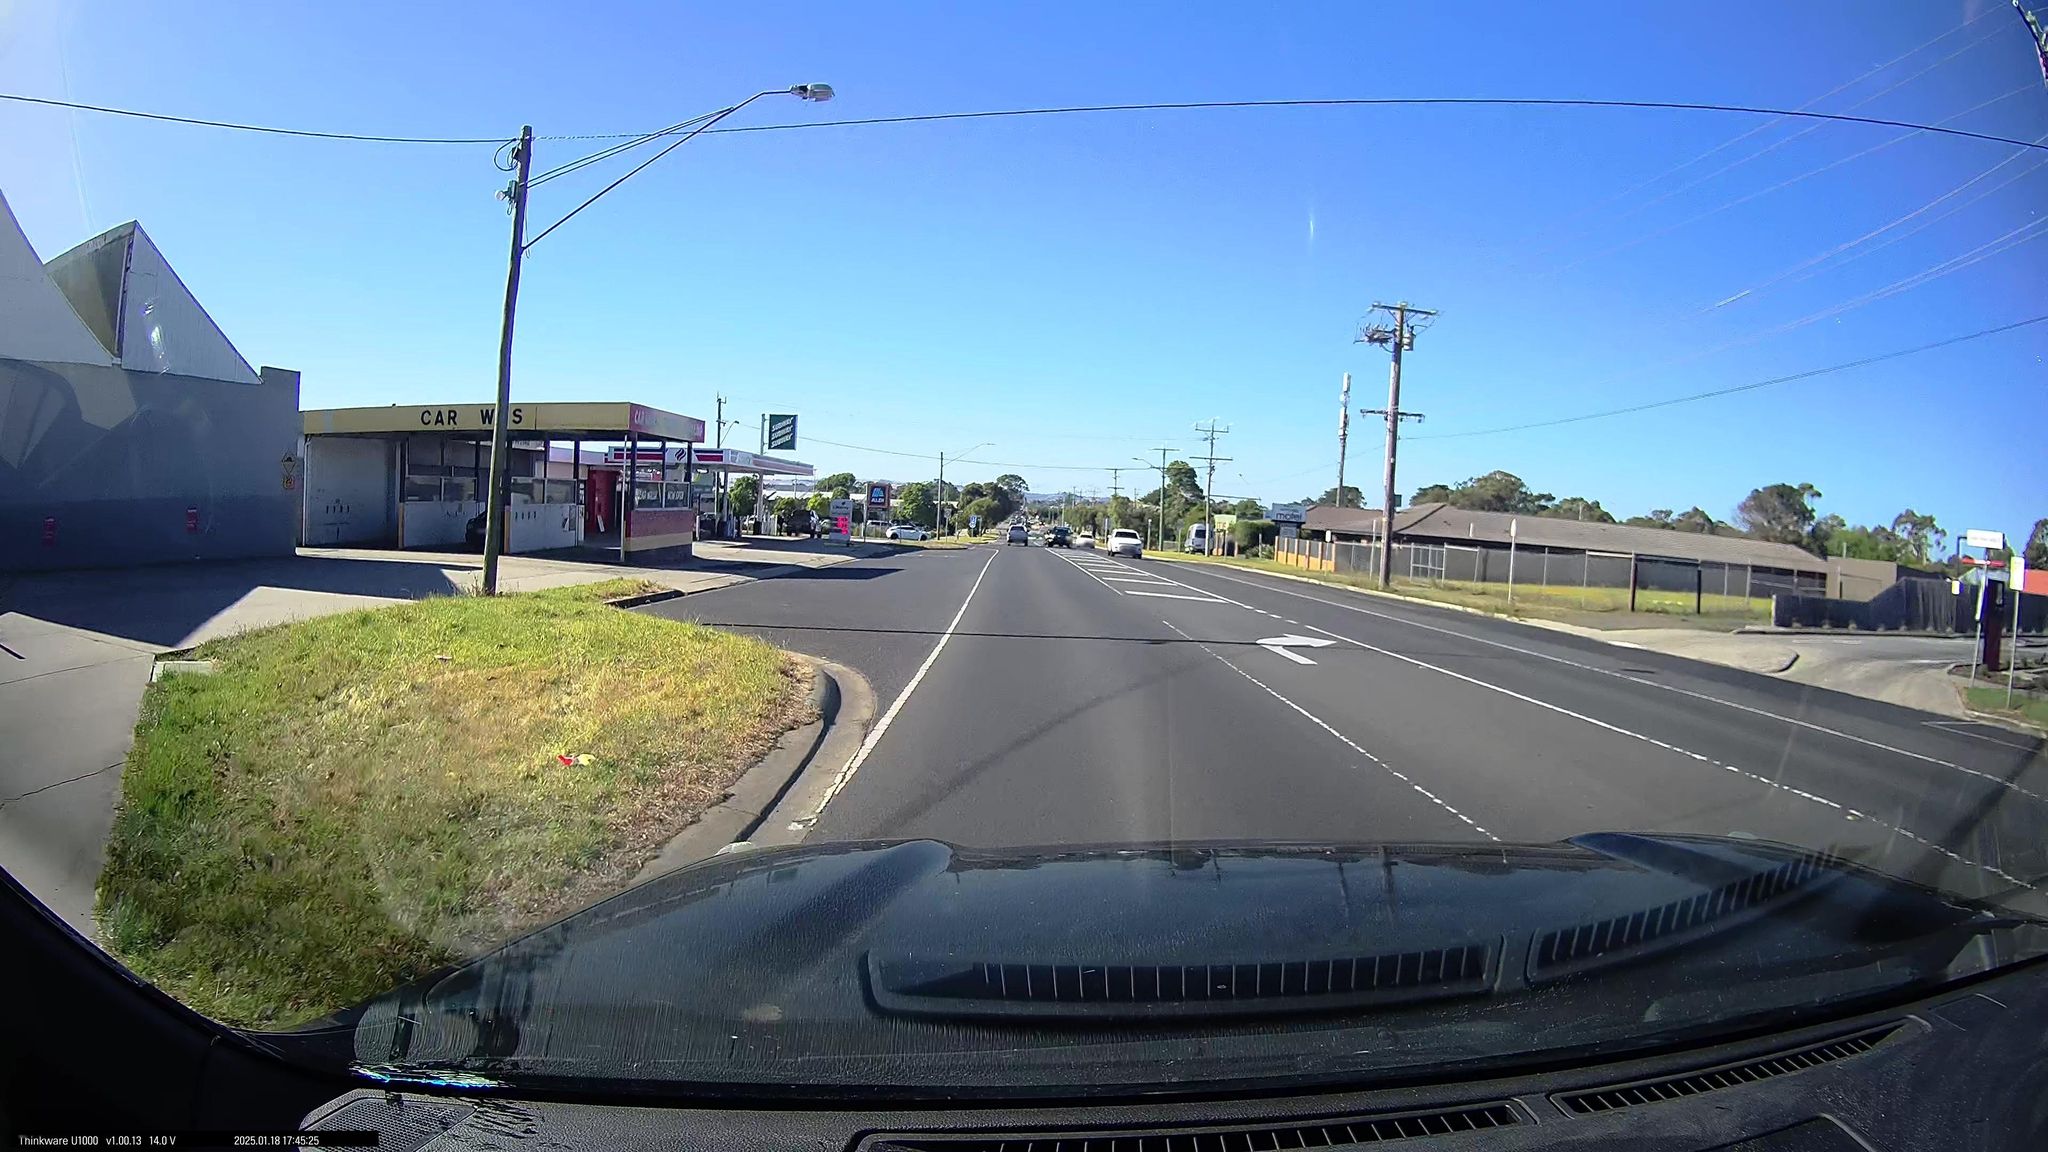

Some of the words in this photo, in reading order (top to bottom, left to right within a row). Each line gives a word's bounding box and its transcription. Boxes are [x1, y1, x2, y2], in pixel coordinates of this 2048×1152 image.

[420, 409, 458, 426] CAR
[480, 408, 523, 425] WS
[1275, 511, 1302, 521] motel
